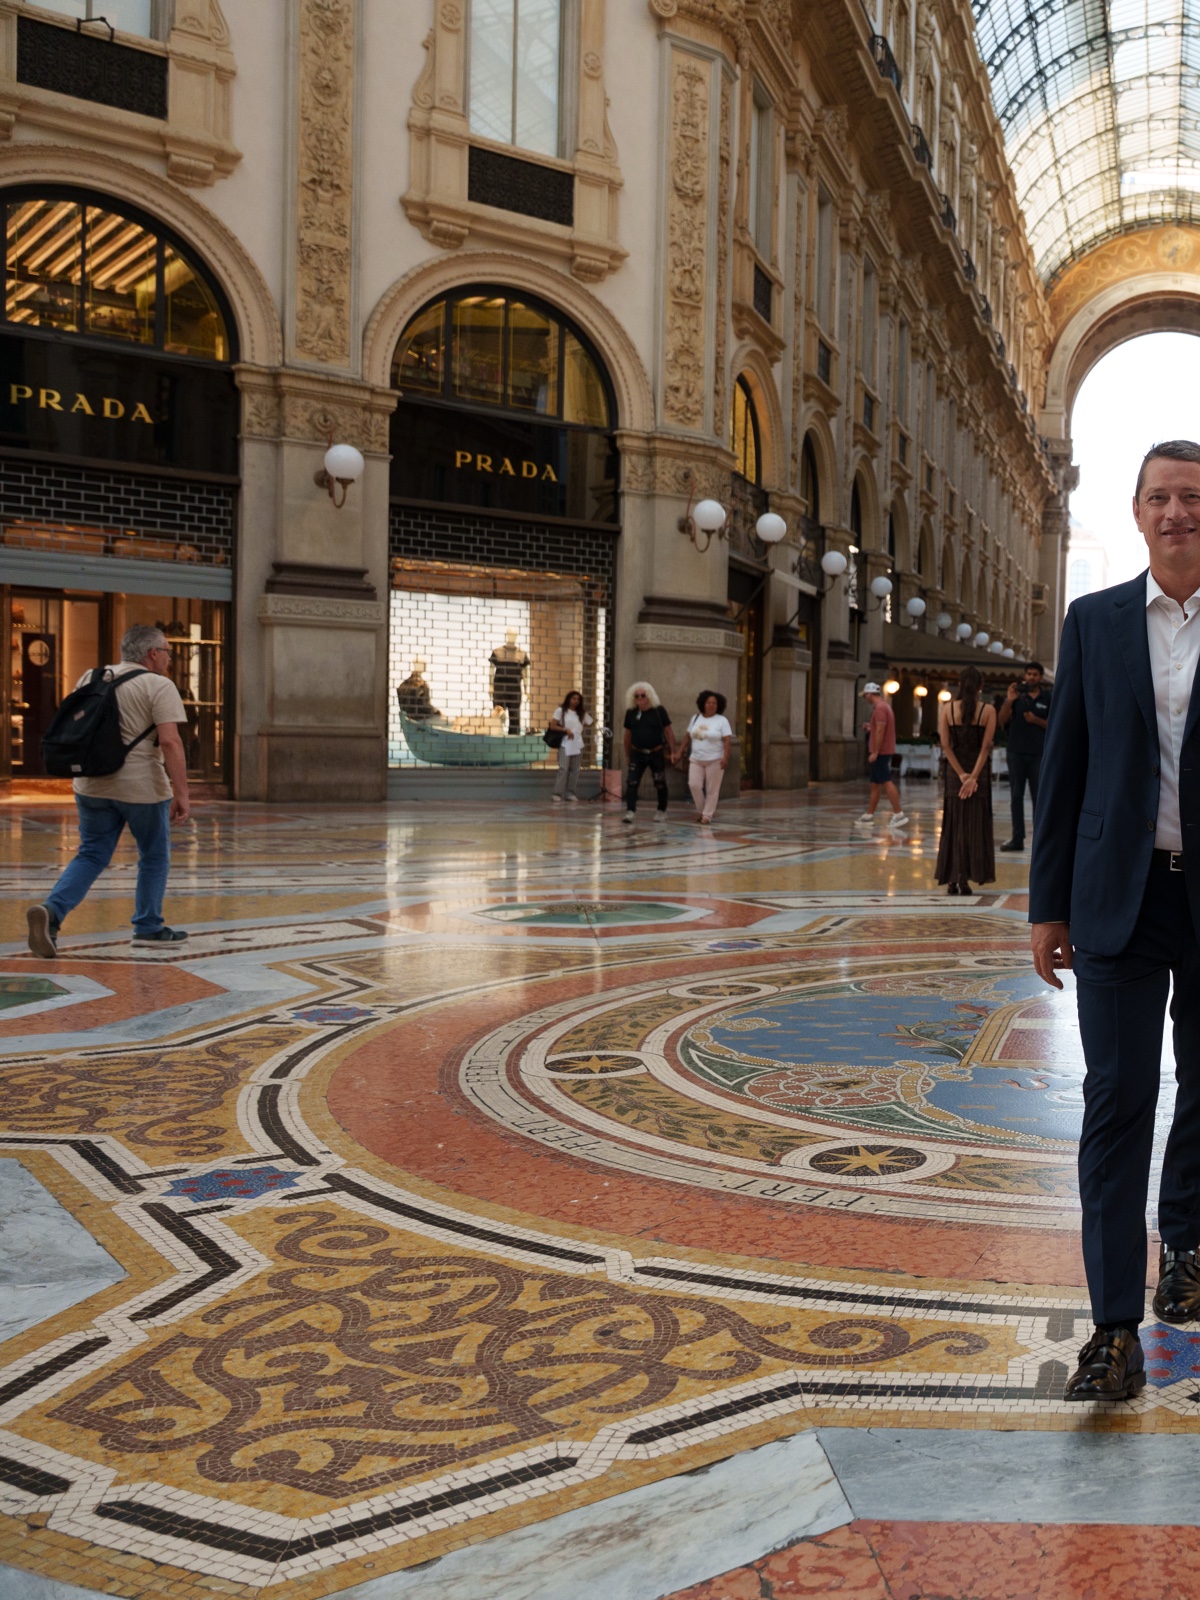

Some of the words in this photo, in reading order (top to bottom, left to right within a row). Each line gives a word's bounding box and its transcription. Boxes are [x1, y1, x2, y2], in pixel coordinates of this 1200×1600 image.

[10, 383, 154, 424] PRADA
[455, 450, 558, 482] PRADA
[511, 1119, 602, 1150] FERT
[721, 1179, 865, 1208] FERT
